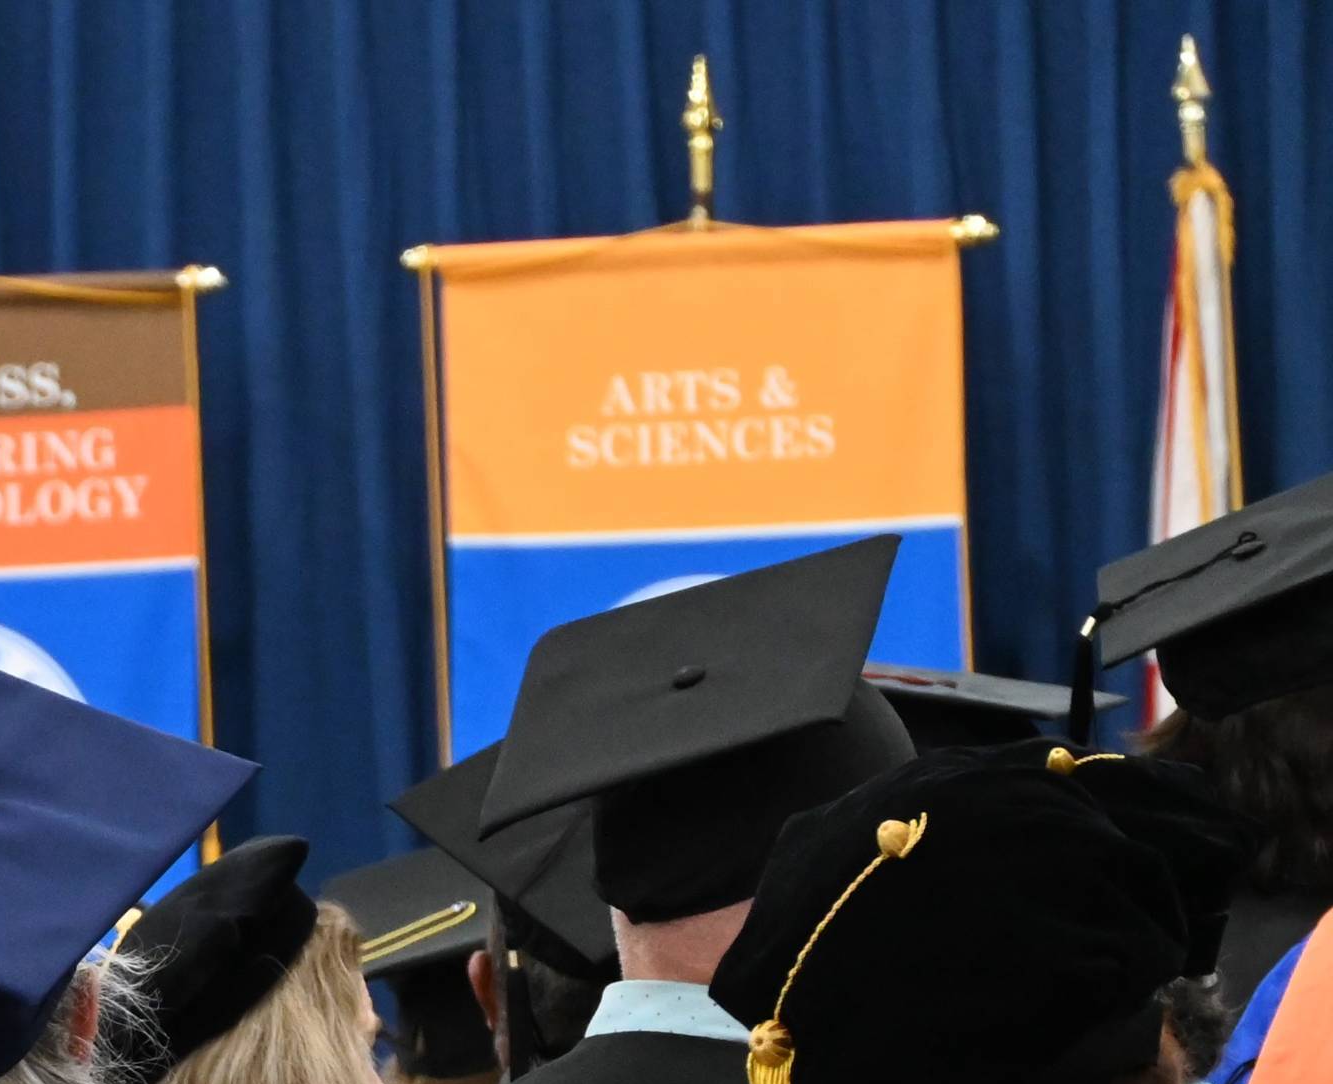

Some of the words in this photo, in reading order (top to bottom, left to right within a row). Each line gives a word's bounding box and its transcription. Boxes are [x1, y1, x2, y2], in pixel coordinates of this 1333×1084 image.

[601, 368, 742, 416] ARTS
[759, 365, 799, 410] &
[566, 415, 836, 468] SCIENCES
